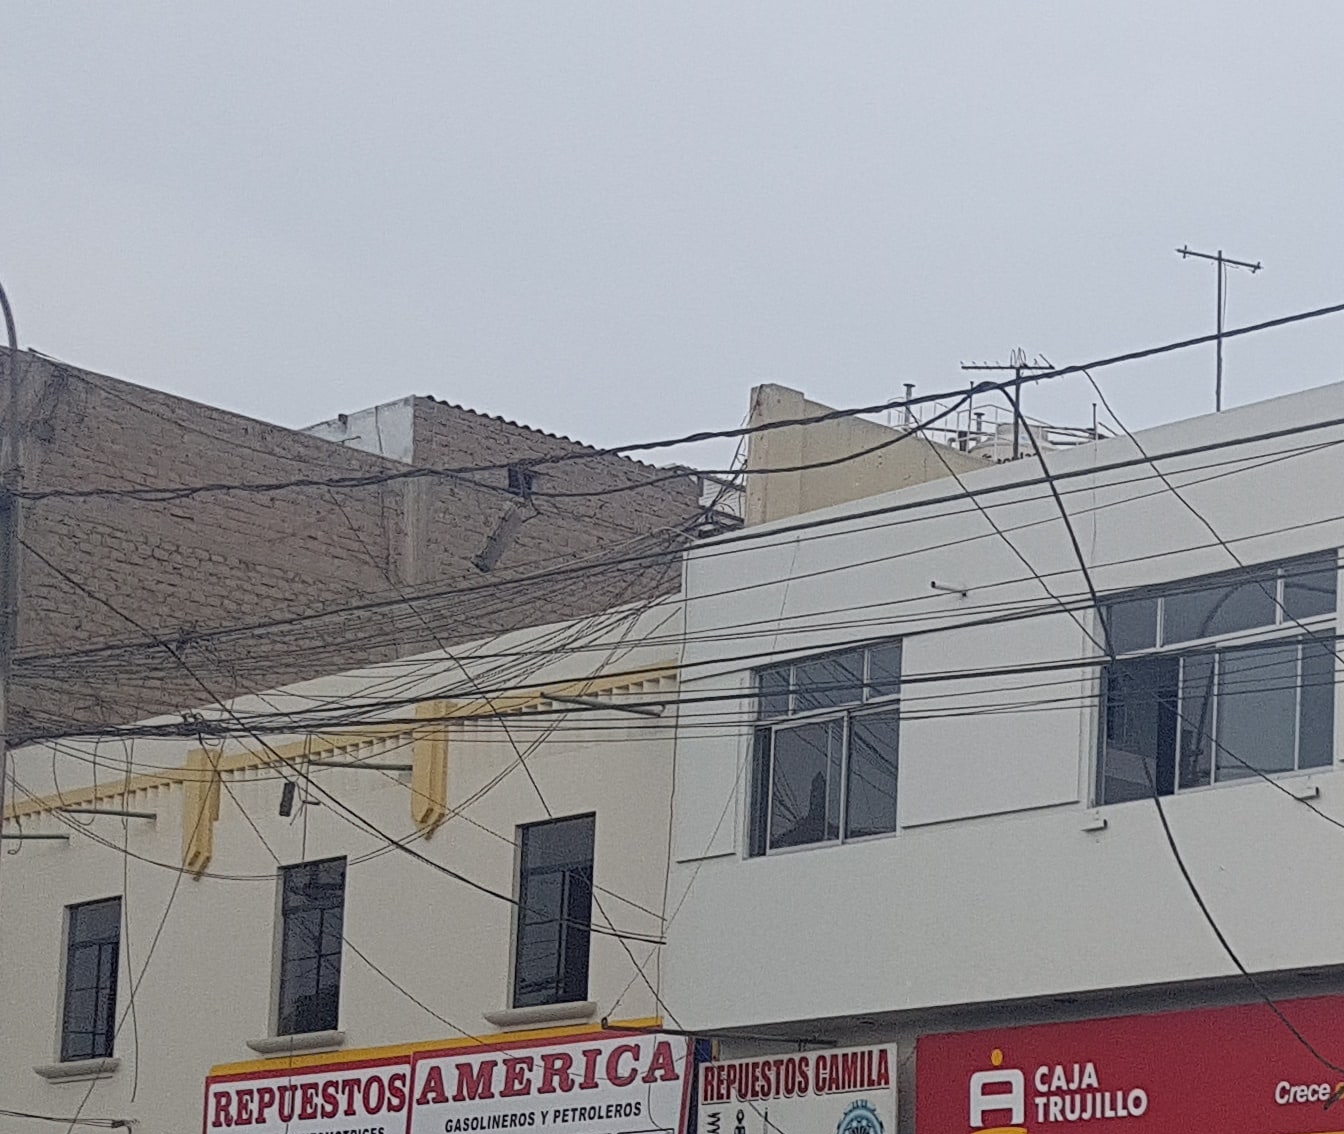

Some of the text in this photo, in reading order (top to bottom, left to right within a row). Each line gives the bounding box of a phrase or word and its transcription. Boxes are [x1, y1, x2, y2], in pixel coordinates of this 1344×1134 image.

[212, 1041, 680, 1128] REPUESTOS AMERICA
[702, 1048, 890, 1102] REPUESTOS CAMILA
[1034, 1062, 1099, 1095] CAJA
[1034, 1089, 1148, 1124] TRUJILLO
[1274, 1080, 1331, 1105] Crece
[445, 1102, 642, 1133] GASOLINEROS Y PETROLEROS
